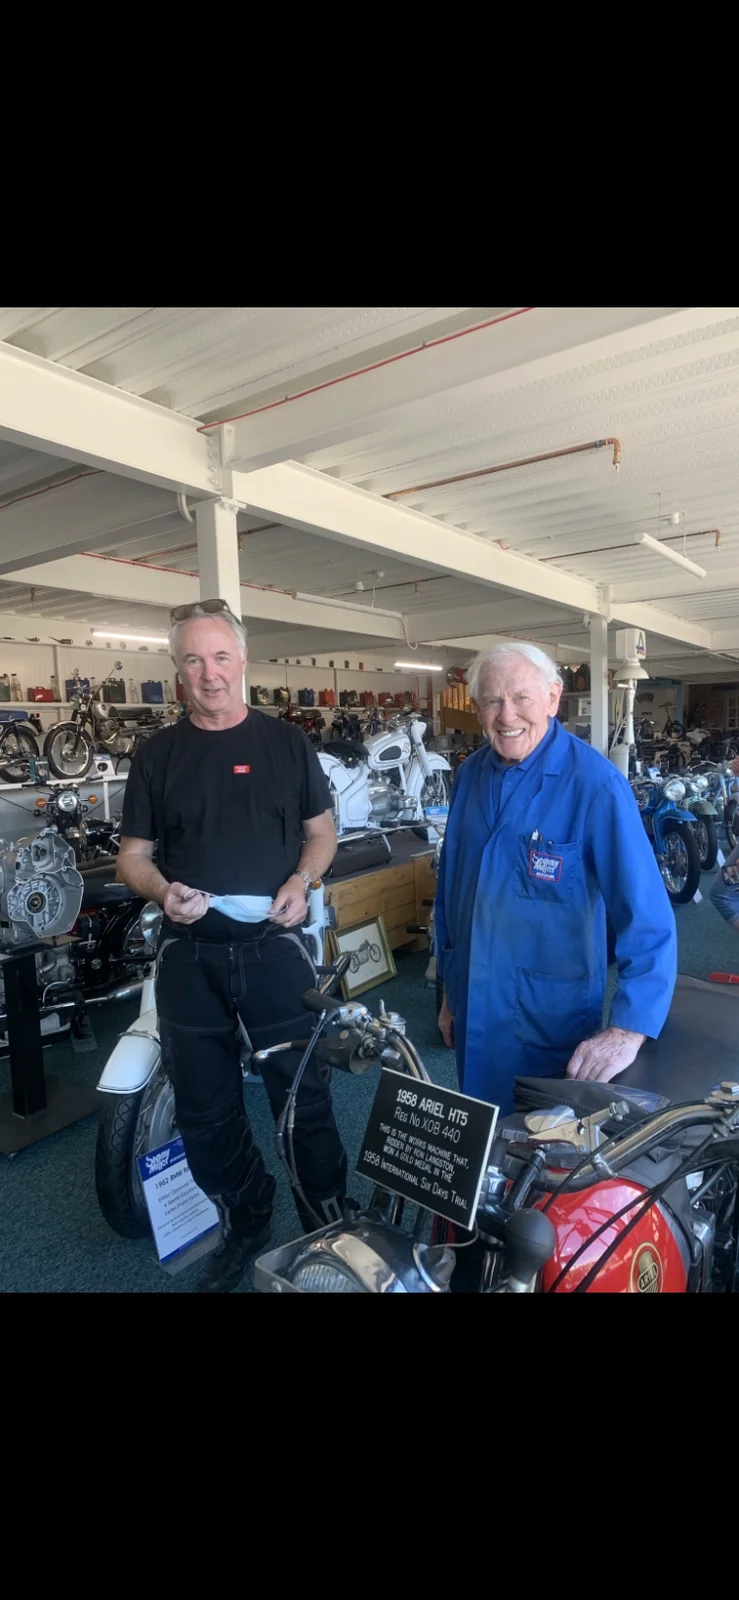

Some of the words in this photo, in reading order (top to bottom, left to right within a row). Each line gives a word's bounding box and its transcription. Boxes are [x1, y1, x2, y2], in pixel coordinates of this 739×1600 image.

[396, 1089, 418, 1107] 1958
[418, 1097, 445, 1118] ARIEL
[447, 1107, 469, 1126] HT5
[380, 1122, 391, 1134] THIS
[391, 1128, 397, 1137] IS
[397, 1130, 408, 1141] THE
[409, 1135, 427, 1150] WORKS
[427, 1143, 452, 1161] MACHINE
[453, 1153, 469, 1169] THAT,
[421, 1118, 441, 1135] XOB
[441, 1126, 461, 1143] 440
[364, 1150, 380, 1167] 1958
[386, 1136, 405, 1150] RIDDEN
[405, 1144, 413, 1153] BY
[413, 1147, 425, 1159] RON
[383, 1144, 395, 1156] WON
[395, 1150, 400, 1158] A
[400, 1152, 414, 1164] GOLD
[414, 1158, 432, 1173] MEDAL
[433, 1167, 440, 1177] IN
[441, 1170, 454, 1183] THE
